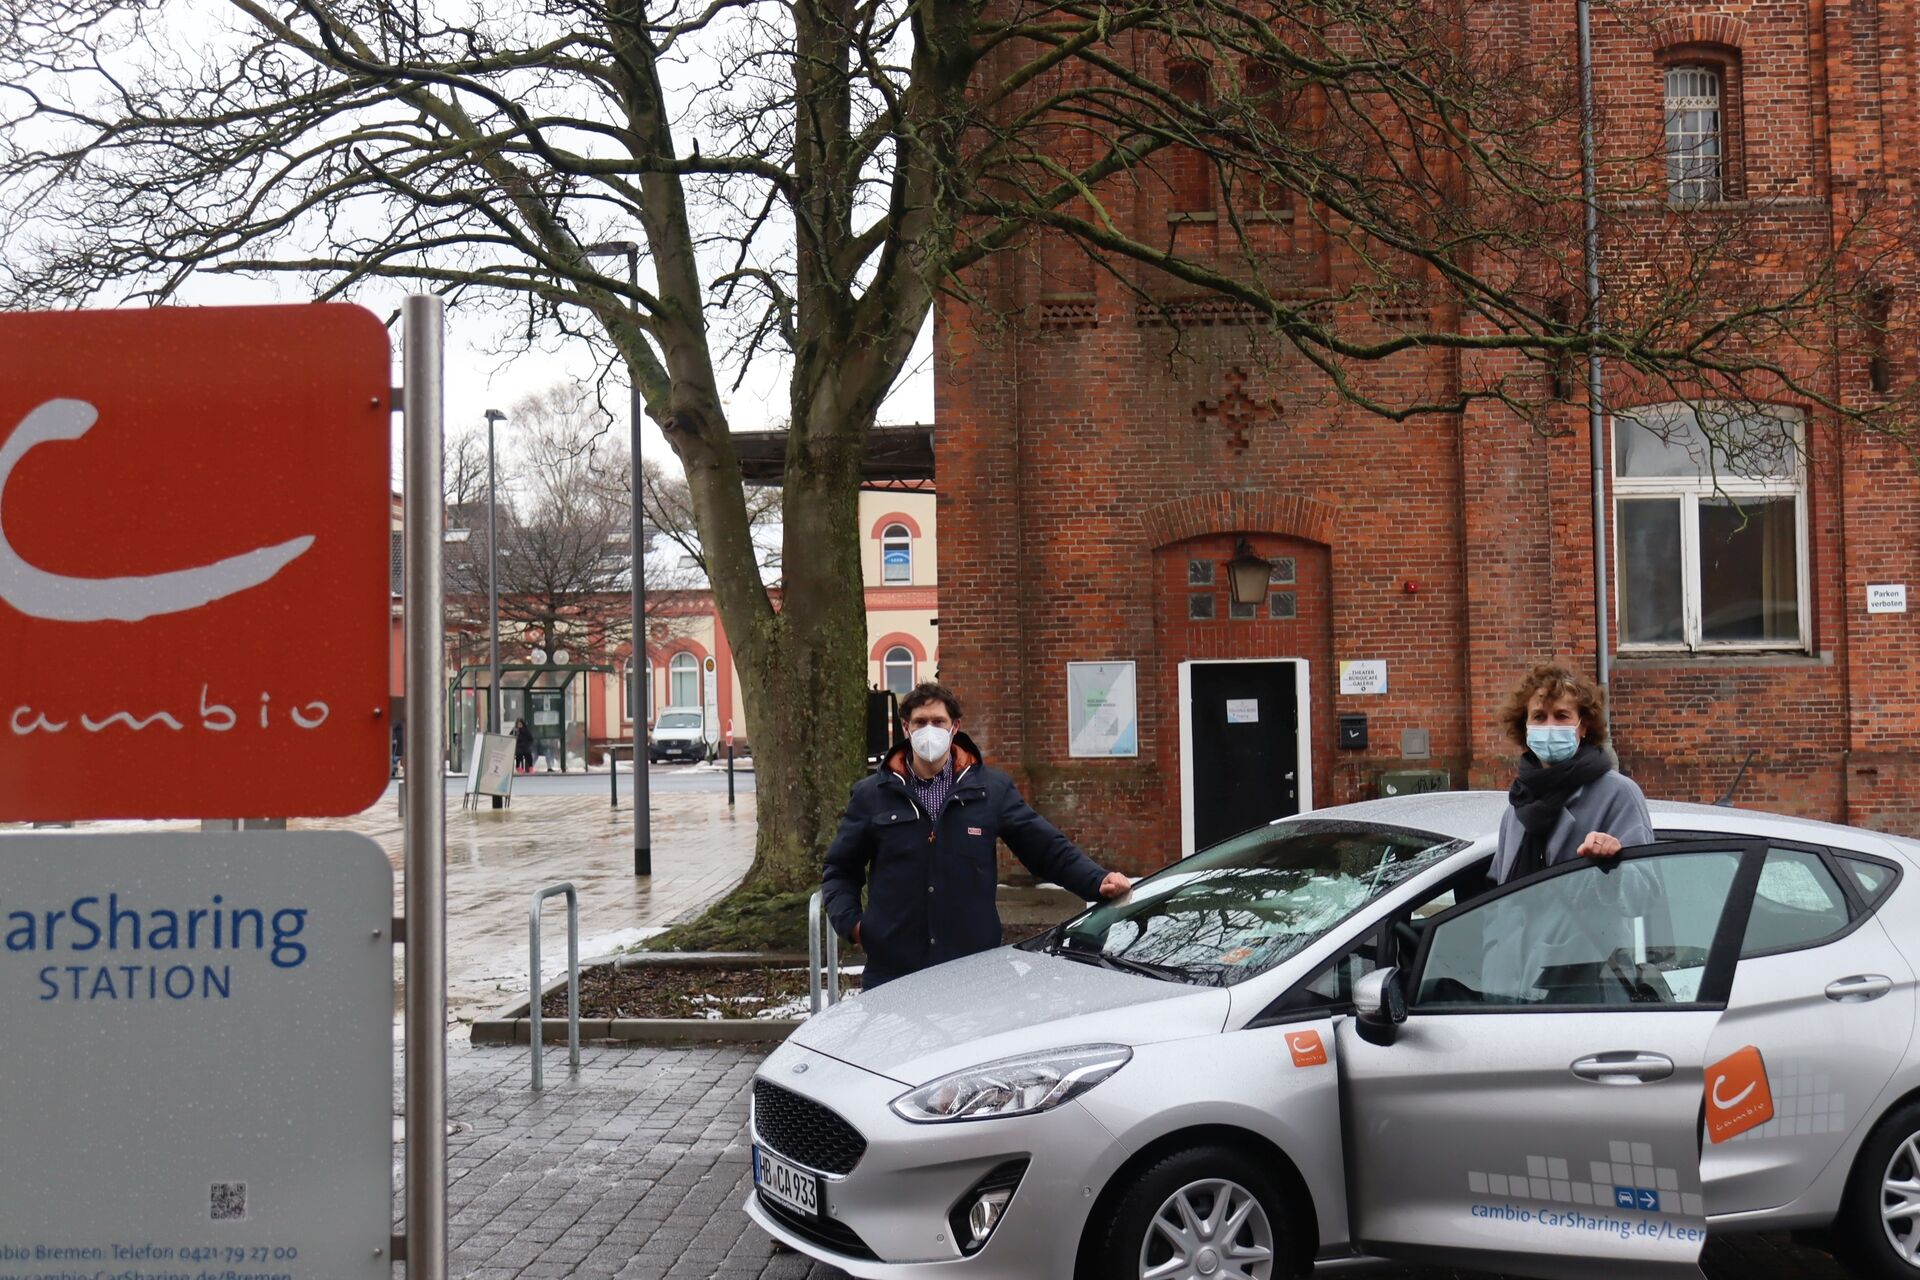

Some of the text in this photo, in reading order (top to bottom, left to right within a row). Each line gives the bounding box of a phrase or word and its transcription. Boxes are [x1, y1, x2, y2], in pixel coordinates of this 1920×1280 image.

[1870, 600, 1903, 608] verboten
[10, 683, 329, 735] ambio
[5, 892, 308, 968] arSharing
[39, 965, 230, 1000] STATION
[1716, 1103, 1764, 1131] cambio
[760, 1156, 772, 1186] HB
[777, 1165, 792, 1199] CA
[793, 1173, 816, 1209] 933
[1471, 1202, 1705, 1242] cambio-CarSharing.de/Leer
[0, 1243, 30, 1260] bio
[111, 1243, 174, 1260] Telefon
[180, 1246, 245, 1263] 0421-79
[250, 1246, 269, 1262] 27
[274, 1246, 298, 1260] 00
